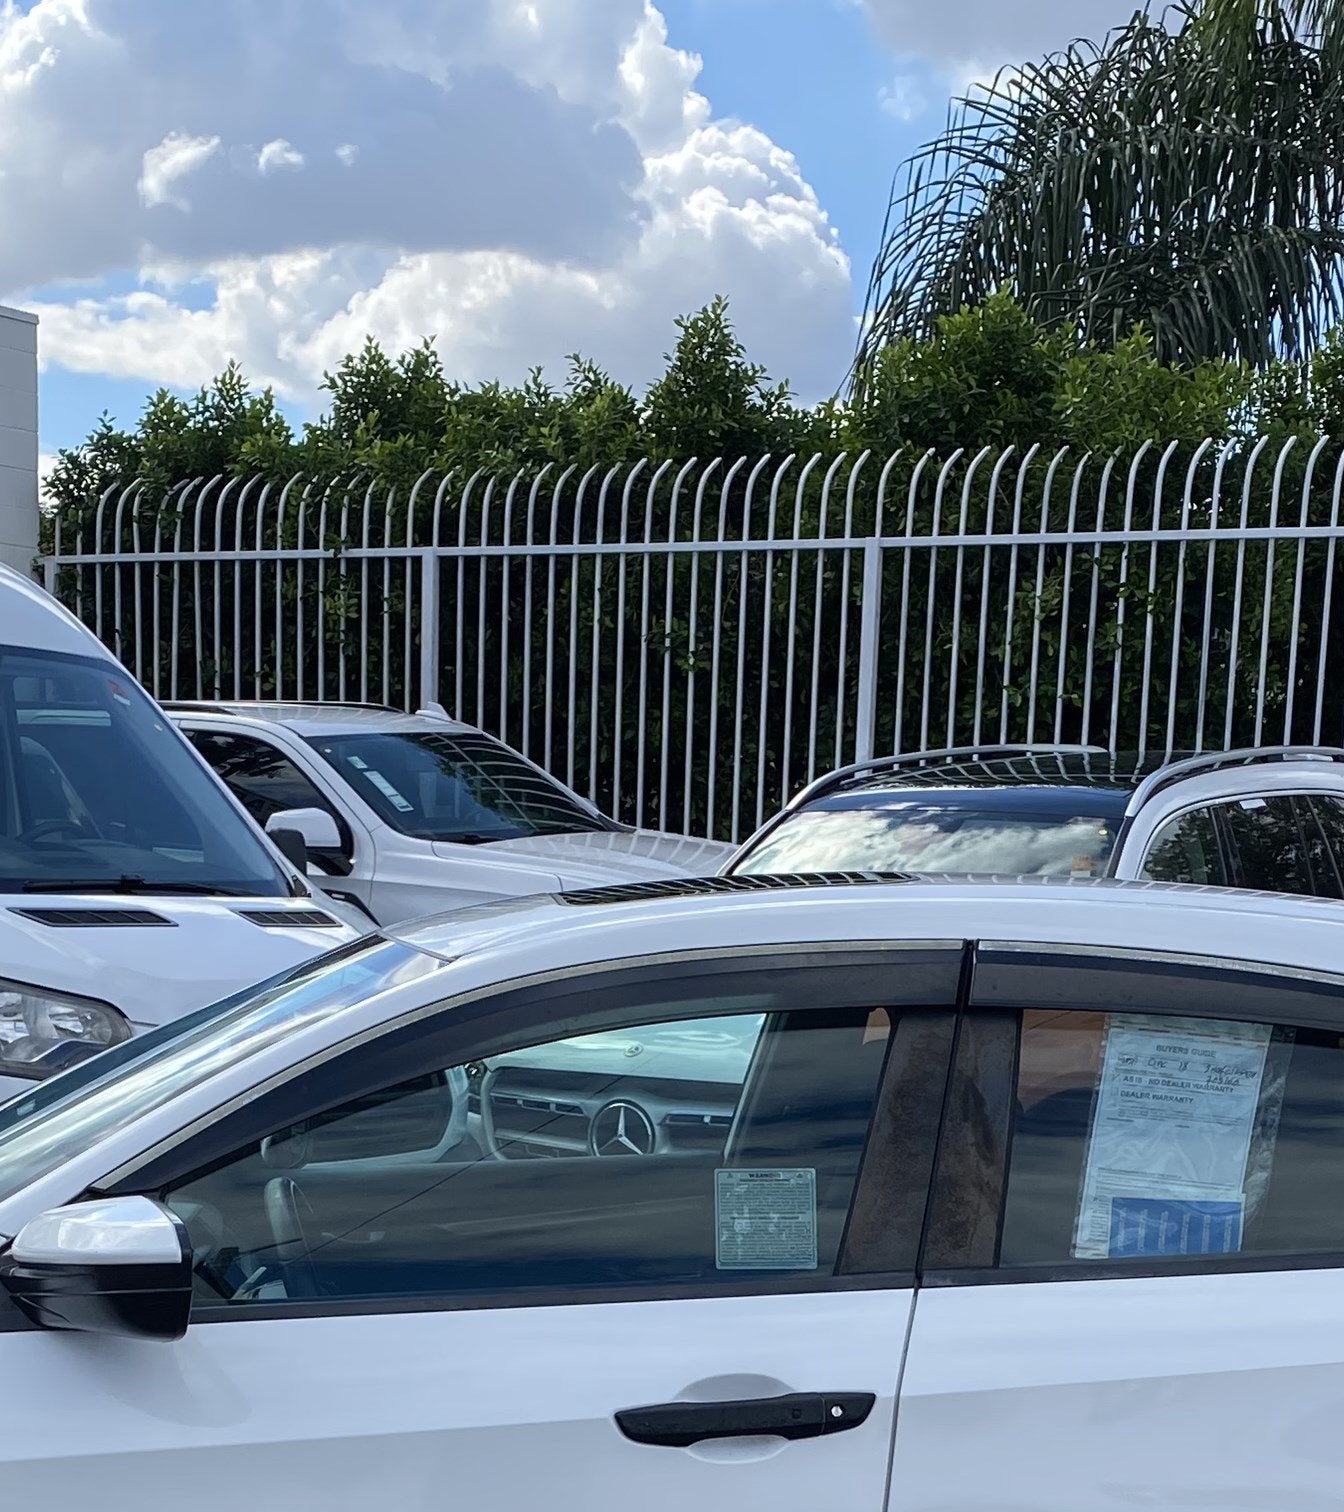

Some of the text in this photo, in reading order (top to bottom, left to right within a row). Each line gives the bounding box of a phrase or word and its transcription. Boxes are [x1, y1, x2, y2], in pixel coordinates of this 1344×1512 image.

[1156, 1044, 1217, 1058] BUYERS GUIDE
[1148, 1078, 1160, 1086] NO
[1161, 1079, 1191, 1089] DEALER
[1120, 1090, 1194, 1104] DEALER WARRANTY
